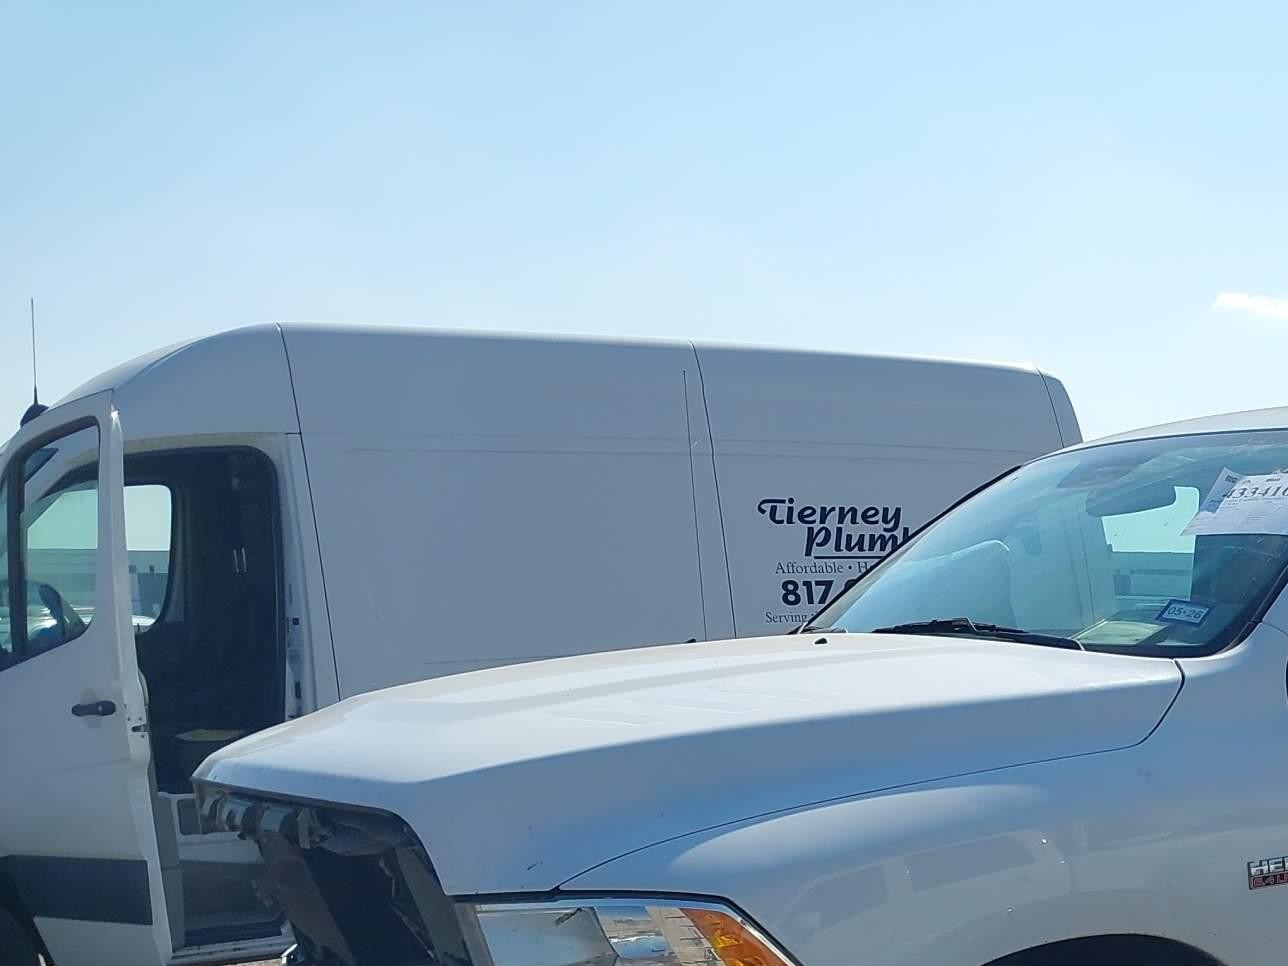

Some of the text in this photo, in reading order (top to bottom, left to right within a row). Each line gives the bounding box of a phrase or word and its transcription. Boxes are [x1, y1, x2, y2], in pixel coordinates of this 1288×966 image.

[757, 497, 902, 533] Tierney
[775, 561, 844, 575] Affordable
[781, 579, 835, 606] 817
[765, 611, 808, 623] Serving
